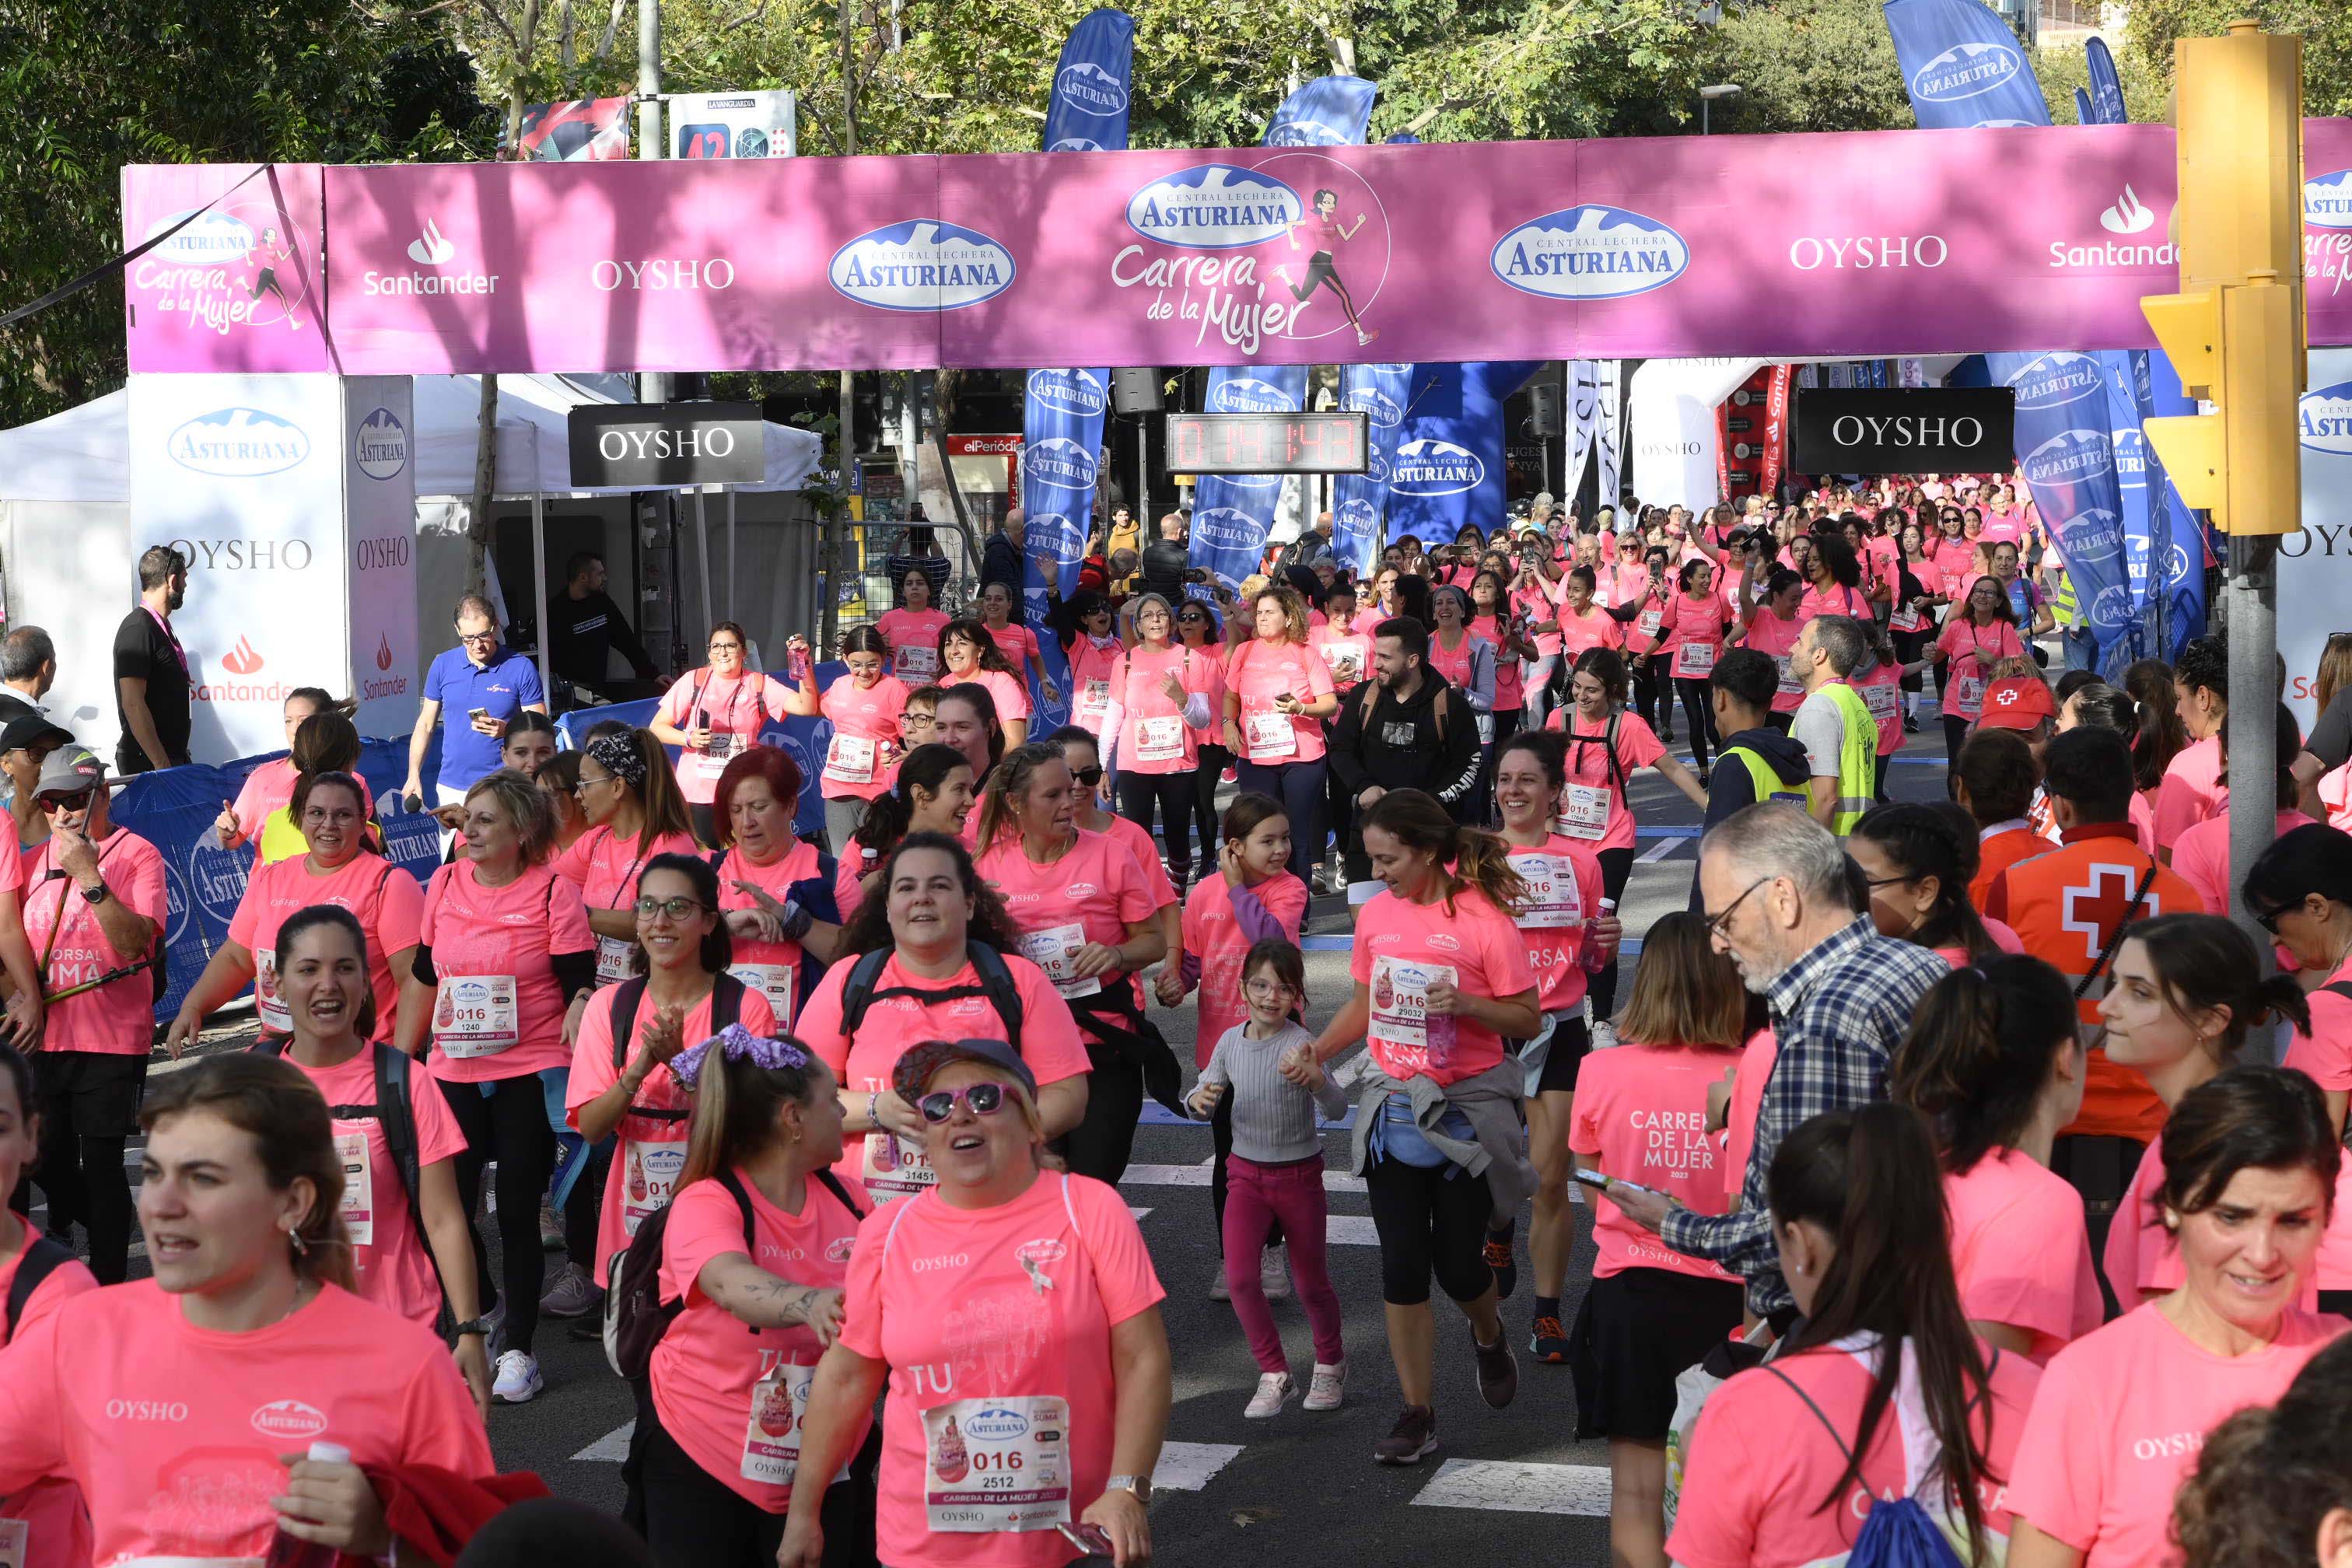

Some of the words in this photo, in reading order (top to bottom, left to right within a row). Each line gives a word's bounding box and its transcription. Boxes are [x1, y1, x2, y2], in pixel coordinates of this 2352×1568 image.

[1167, 193, 1221, 201] CENTRAL
[1228, 192, 1284, 201] LECHERA
[1139, 197, 1289, 228] ASTURIANA
[1536, 237, 1594, 247] CENTRAL
[1604, 236, 1668, 247] LECHERA
[871, 250, 929, 260] CENTRAL
[936, 248, 995, 259] LECHERA
[1507, 242, 1672, 276] ASTURIANA
[1790, 236, 1948, 269] OYSHO
[135, 261, 226, 289] Carrera
[591, 259, 734, 291] OYSHO
[842, 254, 1002, 288] ASTURIANA
[1111, 244, 1256, 287] Carrera
[364, 272, 499, 296] Santander
[158, 293, 174, 311] de
[179, 292, 190, 311] la
[189, 287, 261, 335] Mujer
[1146, 289, 1174, 320] de
[1180, 289, 1199, 319] la
[1195, 282, 1311, 355] Mujer
[1035, 376, 1101, 409] ASTURIANA
[1832, 416, 1983, 447] OYSHO
[180, 433, 299, 460] ASTURIANA
[359, 435, 404, 462] ASTURIANA
[599, 428, 734, 460] OYSHO
[1642, 441, 1701, 456] OYSHO
[1030, 450, 1092, 482] ASTURIANA
[1399, 457, 1432, 466] CENTRAL
[1391, 467, 1477, 483] ASTURIANA
[1195, 517, 1259, 545] ASTURIANA
[2277, 524, 2352, 558] OY
[357, 535, 408, 572] OYSHO
[364, 675, 408, 702] Santander
[839, 752, 856, 761] 016
[1570, 805, 1588, 814] 016
[1066, 887, 1096, 896] ASTURIANA
[1429, 938, 1458, 949] ASTURIANA
[602, 954, 621, 967] 016
[602, 968, 617, 976] 31928
[1396, 973, 1427, 986] ASTURIANA
[1396, 993, 1425, 1008] 016
[456, 1008, 485, 1020] 016
[1398, 1008, 1422, 1018] 29032
[1649, 1130, 1675, 1149] DE
[1685, 1132, 1710, 1150] LA
[646, 1159, 681, 1168] ASTURIAN
[1644, 1150, 1714, 1169] MUJER
[875, 1181, 905, 1190] CARRERA
[905, 1171, 933, 1181] 31451
[912, 1253, 969, 1274] OYSHO
[1628, 1243, 1681, 1267] OYSHO
[908, 1363, 954, 1395] TU
[106, 1398, 188, 1423] OYSHO
[1034, 1412, 1059, 1423] SUMA
[968, 1417, 1025, 1433] ASTURIANA
[761, 1446, 798, 1458] CARRERA
[973, 1451, 1024, 1472] 016
[982, 1476, 1014, 1489] 2512
[943, 1494, 982, 1503] CARRERA
[984, 1493, 995, 1502] DE
[996, 1493, 1008, 1502] LA
[1010, 1492, 1038, 1502] MUJER
[941, 1511, 984, 1523] OYSHO
[1020, 1509, 1059, 1522] Santander
